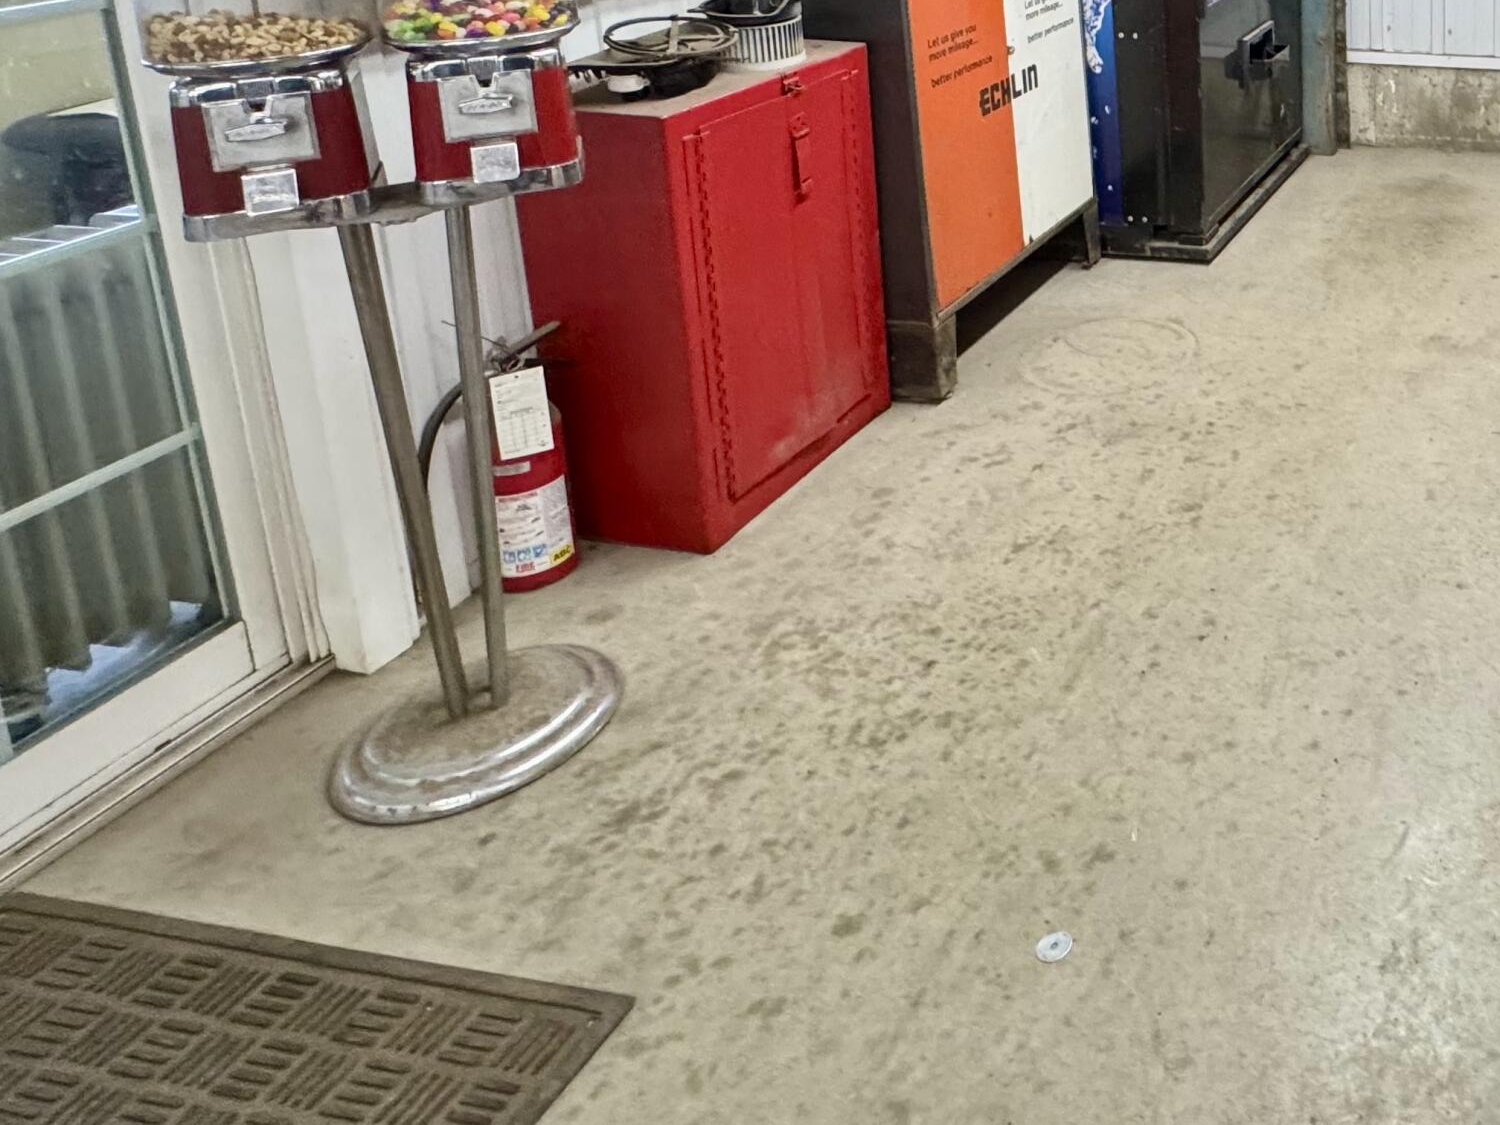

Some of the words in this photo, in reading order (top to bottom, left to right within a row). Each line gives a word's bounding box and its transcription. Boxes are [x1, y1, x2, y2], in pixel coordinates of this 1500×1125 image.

[928, 37, 939, 49] Let
[941, 35, 949, 43] us
[950, 29, 964, 42] give
[965, 24, 976, 34] you
[929, 49, 946, 62] more
[979, 64, 1039, 117] ECHLIN
